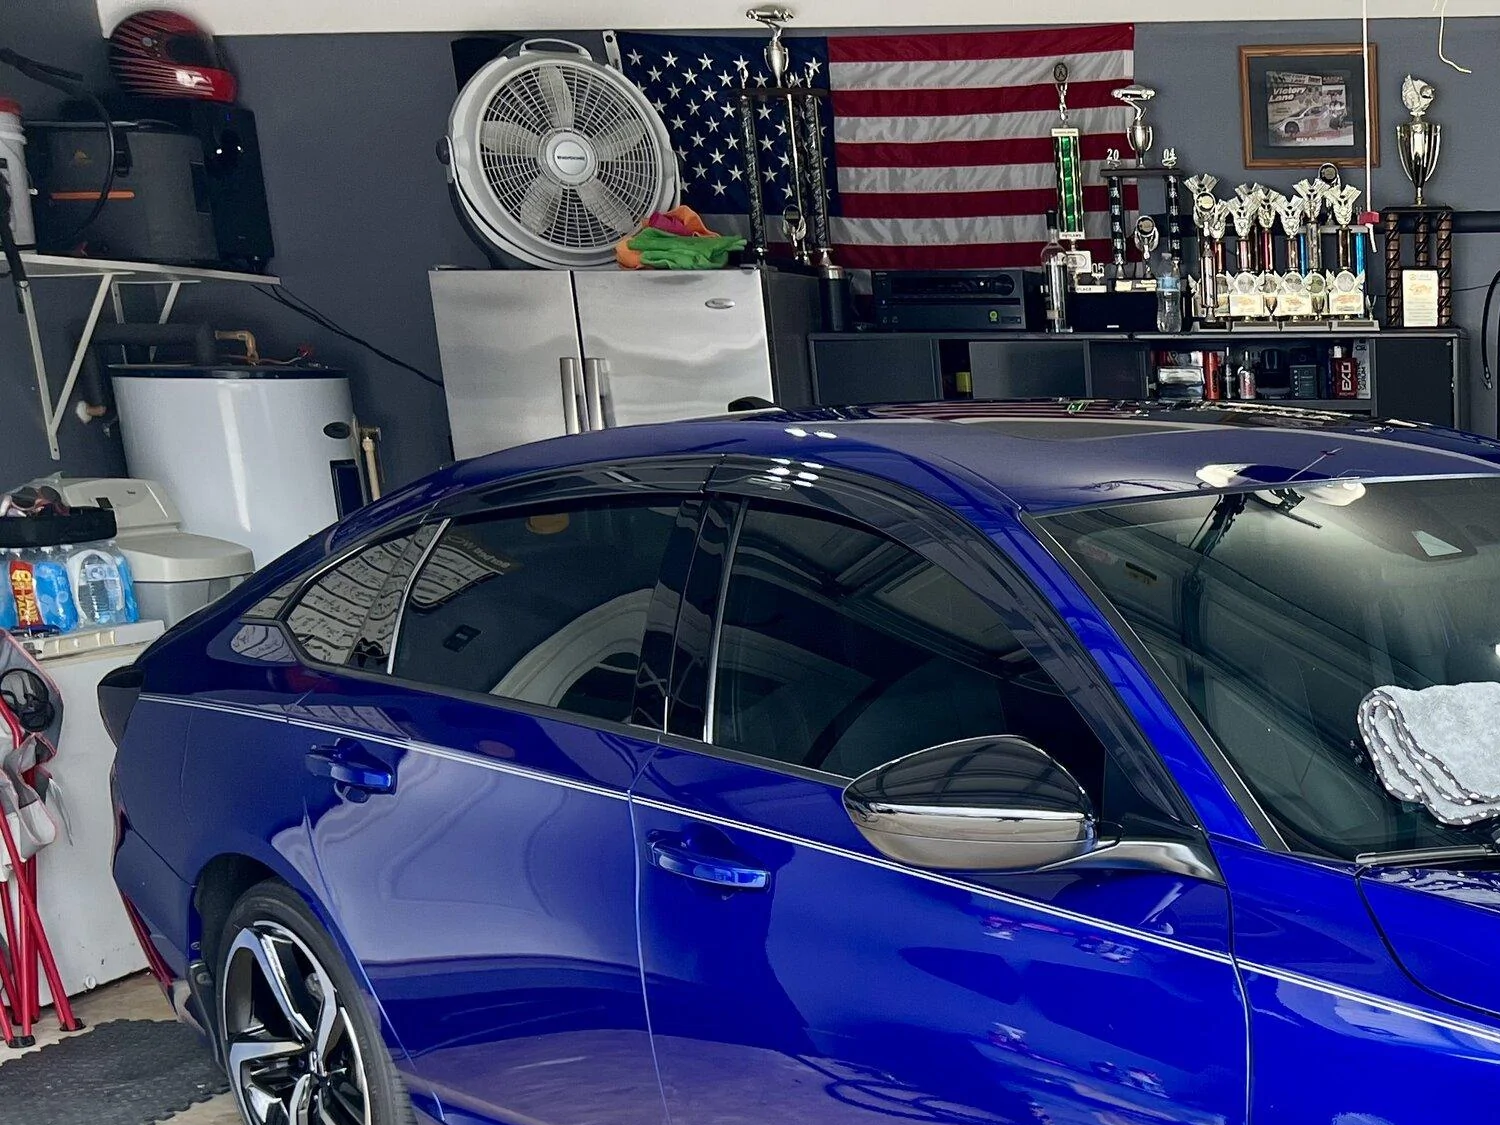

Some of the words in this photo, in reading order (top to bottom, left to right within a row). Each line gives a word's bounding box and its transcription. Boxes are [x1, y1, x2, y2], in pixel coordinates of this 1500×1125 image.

[1273, 86, 1307, 95] Victory
[1106, 148, 1120, 161] 20
[1091, 262, 1105, 274] 05
